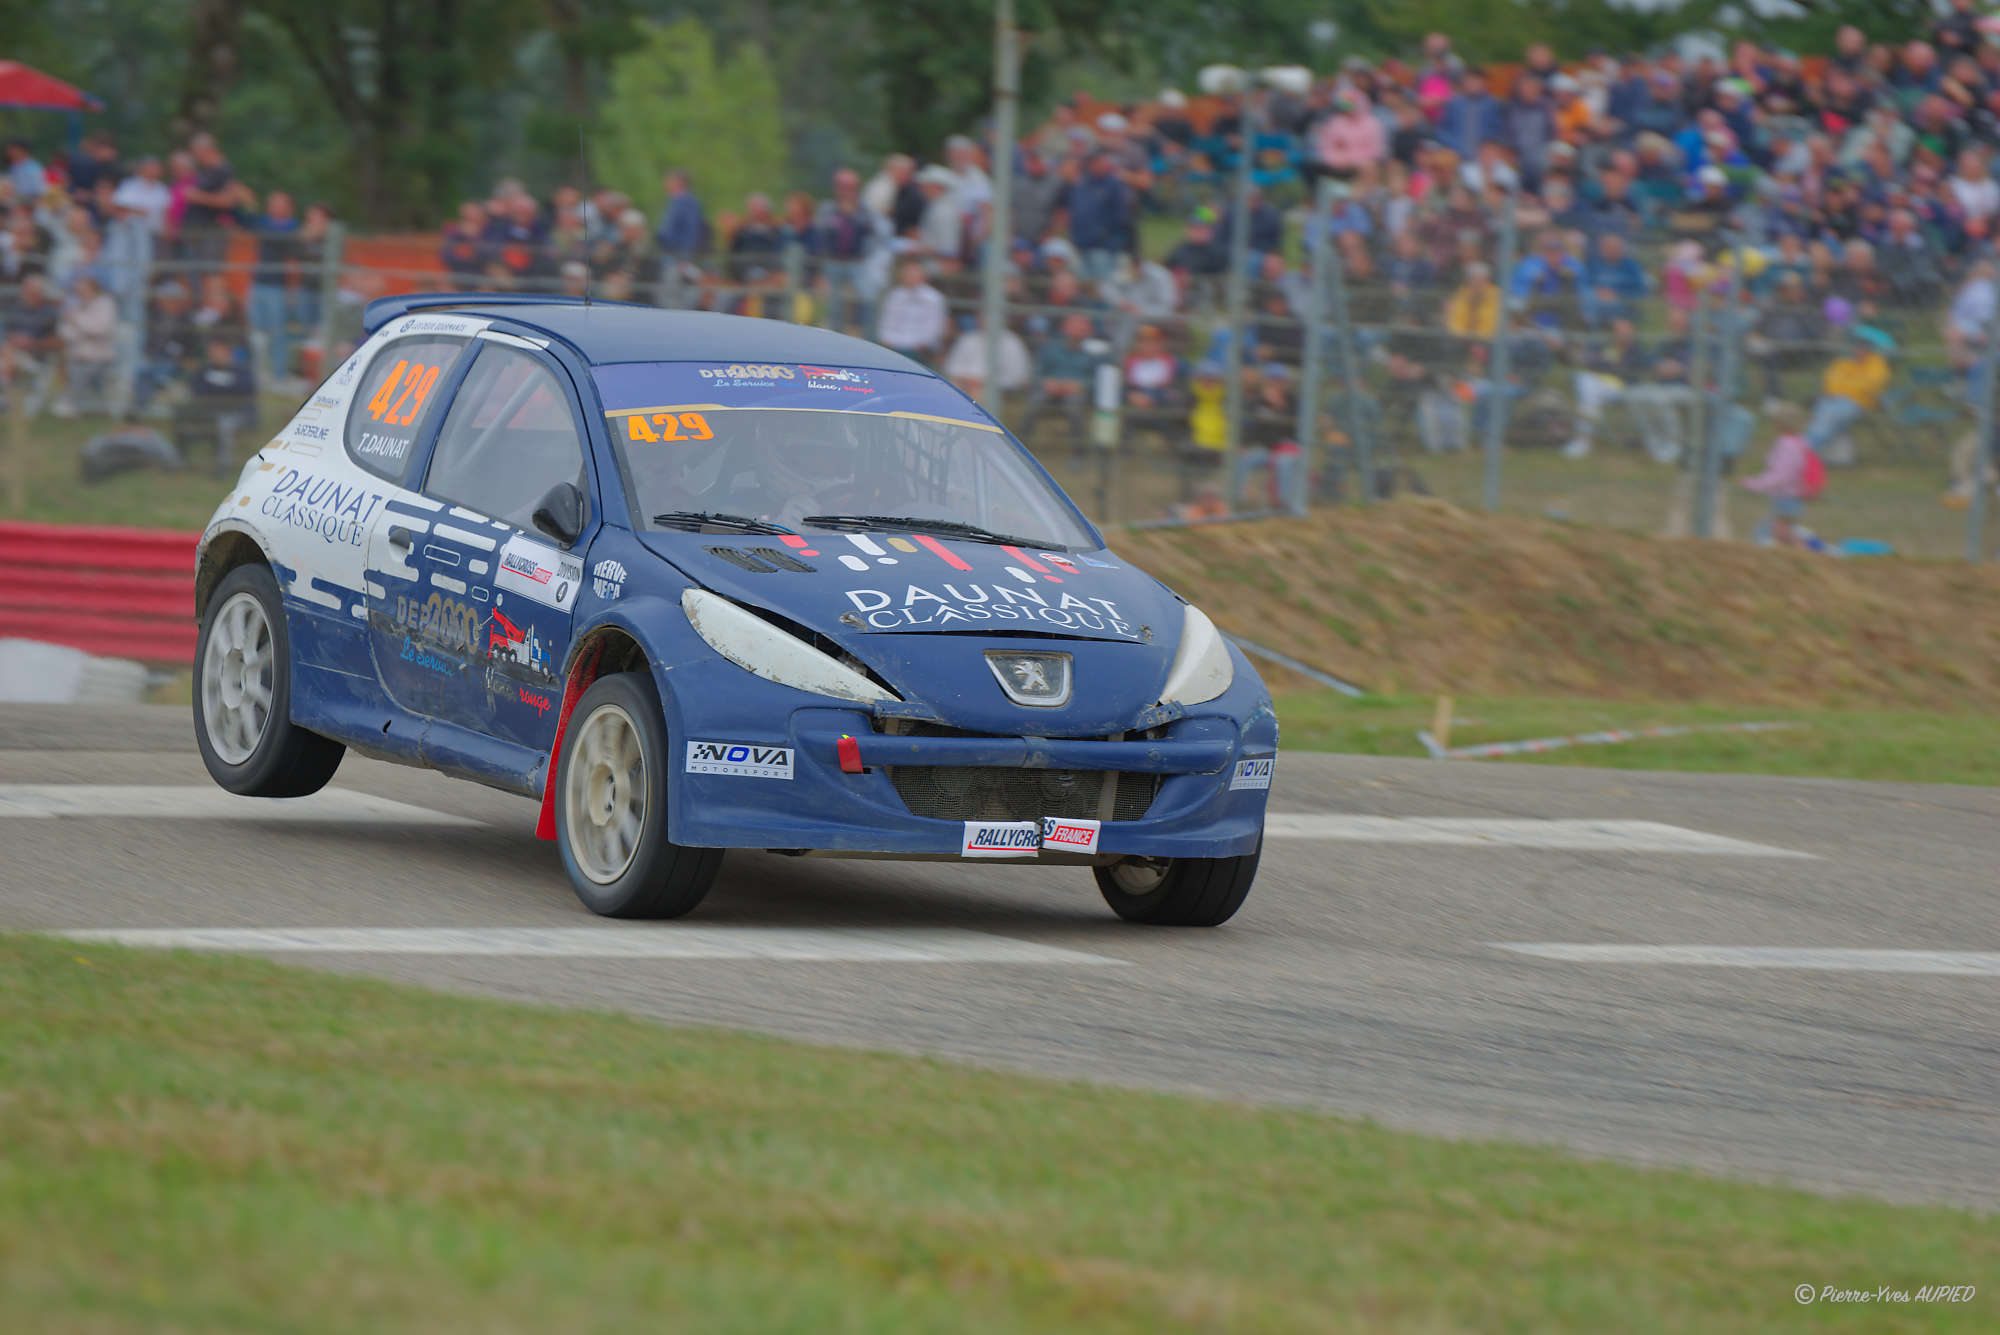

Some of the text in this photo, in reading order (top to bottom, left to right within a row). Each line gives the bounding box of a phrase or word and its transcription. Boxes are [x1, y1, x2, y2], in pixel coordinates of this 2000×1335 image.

[368, 360, 440, 426] 429
[627, 413, 714, 443] 429
[357, 432, 409, 458] T.DAUNAT
[272, 469, 383, 523] DAUNAT
[261, 495, 364, 547] CLASSIQUE
[505, 552, 540, 576] RALLYCROSS
[593, 559, 628, 584] HERVE
[844, 583, 1123, 621] DAUNAT
[867, 602, 1138, 639] CLASSIQUE
[519, 687, 552, 719] rouge
[702, 744, 789, 766] NOVA
[692, 765, 788, 777] MOTORSPORT
[1055, 829, 1093, 845] FRANCE
